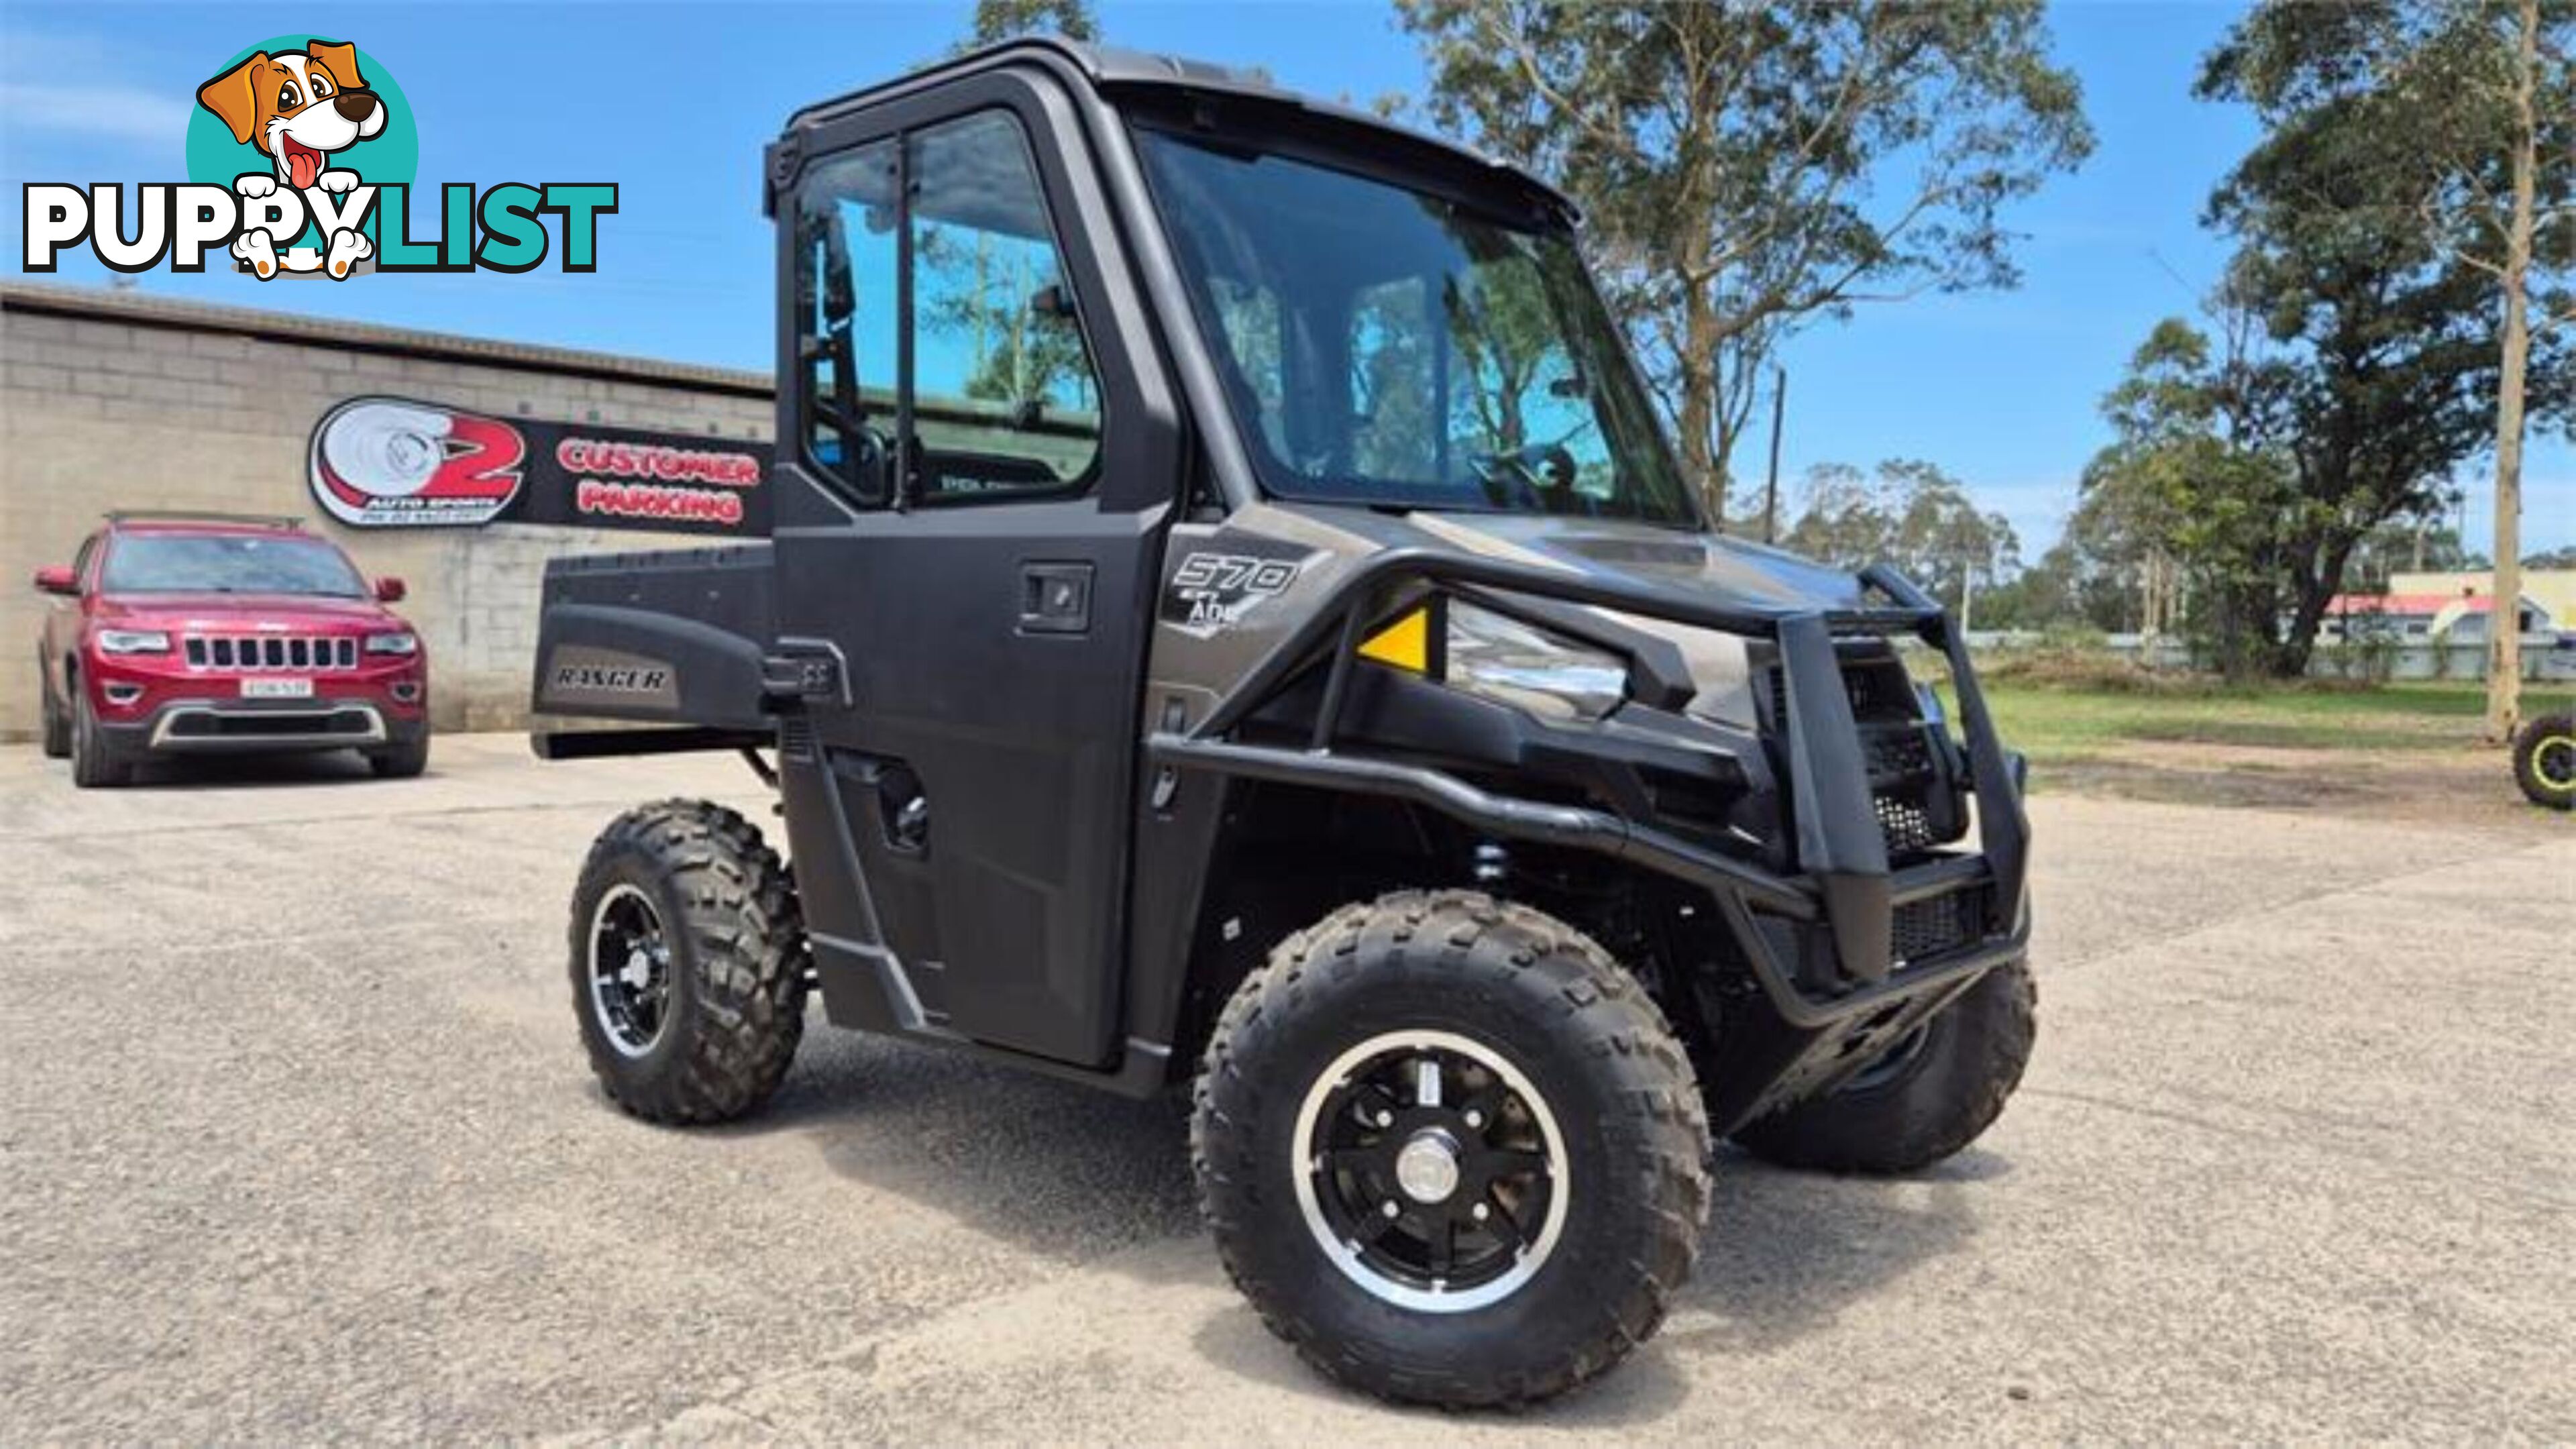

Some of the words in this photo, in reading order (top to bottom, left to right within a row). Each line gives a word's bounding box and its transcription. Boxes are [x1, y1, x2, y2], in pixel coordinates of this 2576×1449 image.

[556, 437, 759, 486] CUSTOMER
[577, 478, 743, 525] PARKING
[1173, 552, 1299, 595] 570
[558, 667, 665, 691] RANGER
